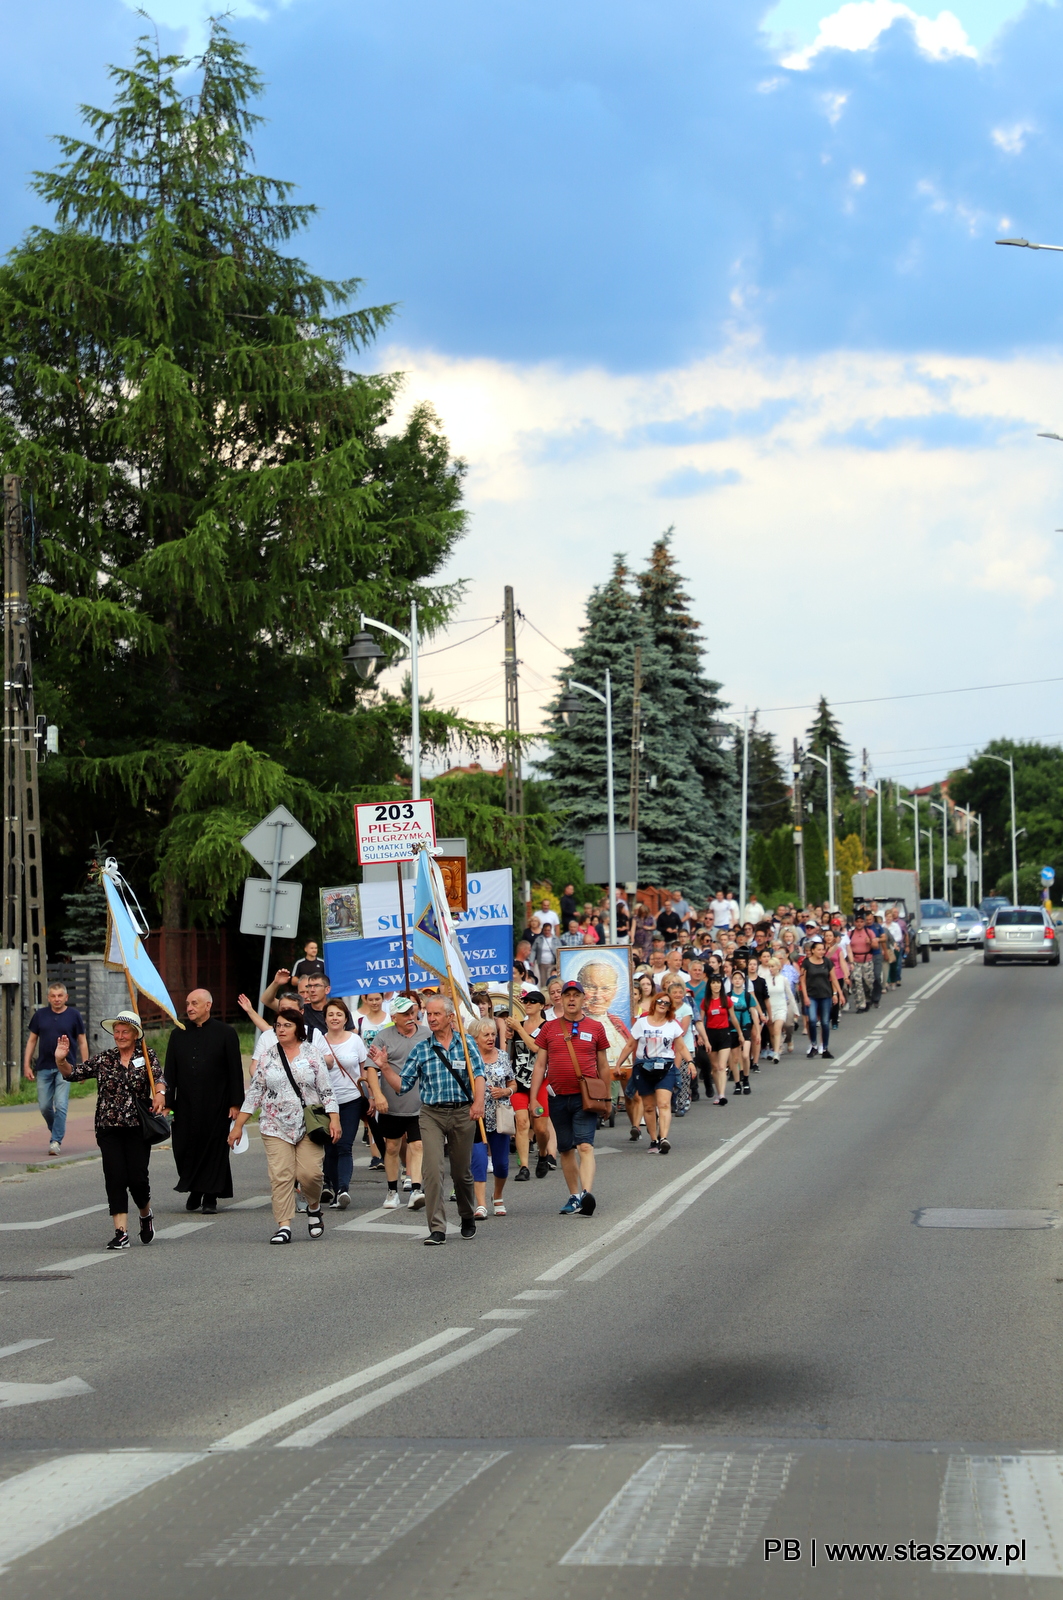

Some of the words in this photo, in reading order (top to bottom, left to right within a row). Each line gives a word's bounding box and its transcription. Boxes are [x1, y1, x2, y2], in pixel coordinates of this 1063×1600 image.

[374, 804, 415, 821] 203
[368, 821, 422, 834] PIESZA
[361, 831, 432, 844] PIELGRZYMKA
[377, 843, 404, 851] MATKI
[364, 850, 416, 860] SULISŁAWS
[357, 977, 374, 988] W
